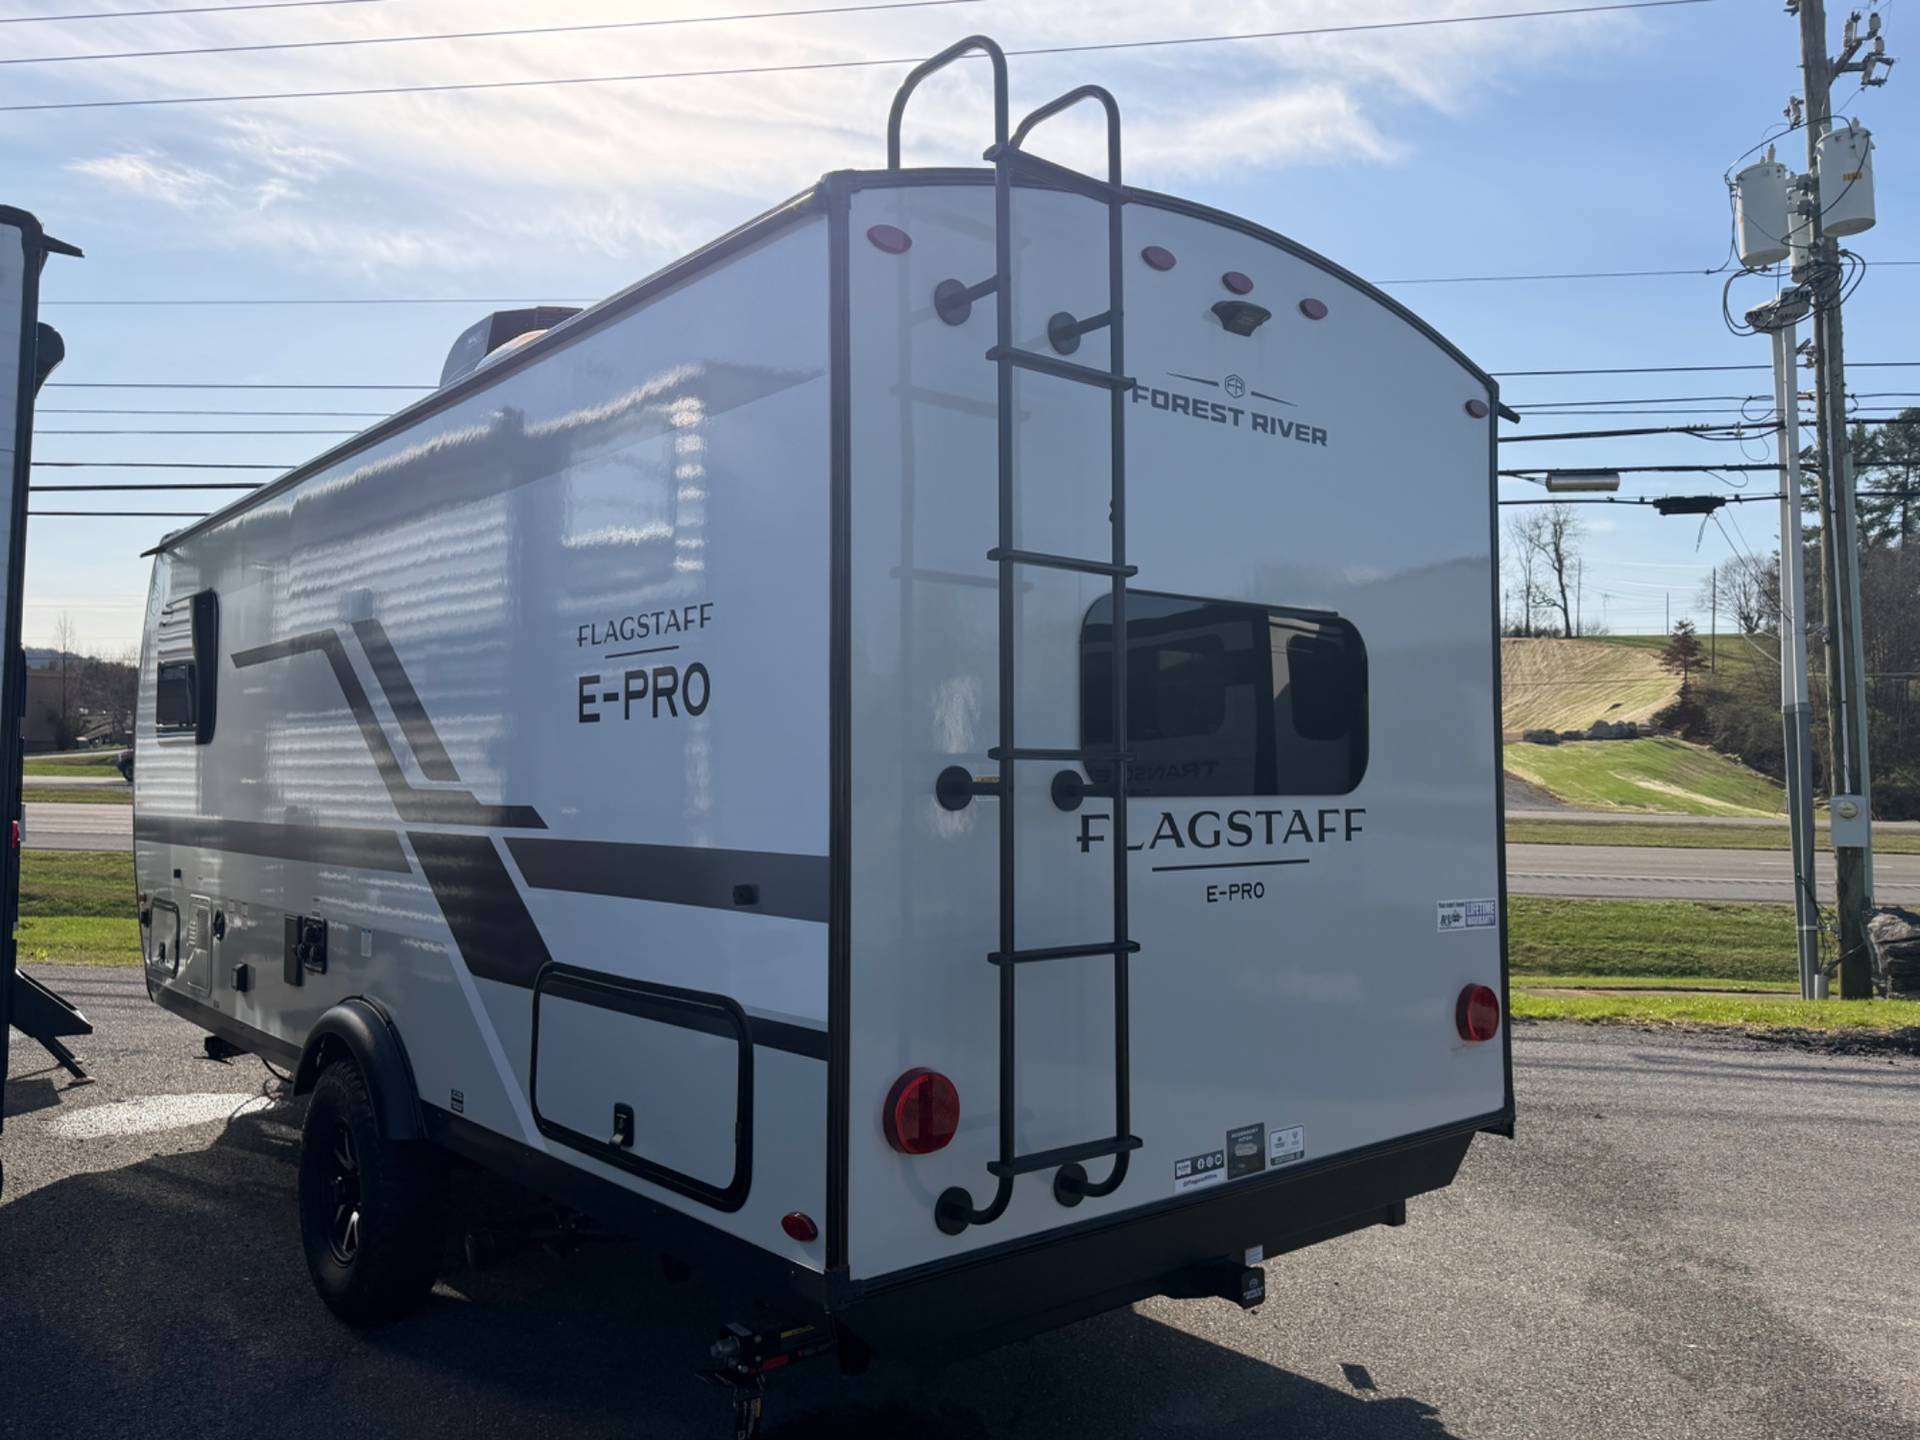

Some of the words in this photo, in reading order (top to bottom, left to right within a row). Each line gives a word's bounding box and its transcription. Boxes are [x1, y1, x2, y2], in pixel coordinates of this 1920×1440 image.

[1132, 385, 1244, 427] FOREST
[1251, 411, 1328, 447] RIVER
[577, 602, 714, 647] FLAGSTAFF
[578, 661, 711, 723] E-PRO
[1206, 881, 1265, 903] E-PRO
